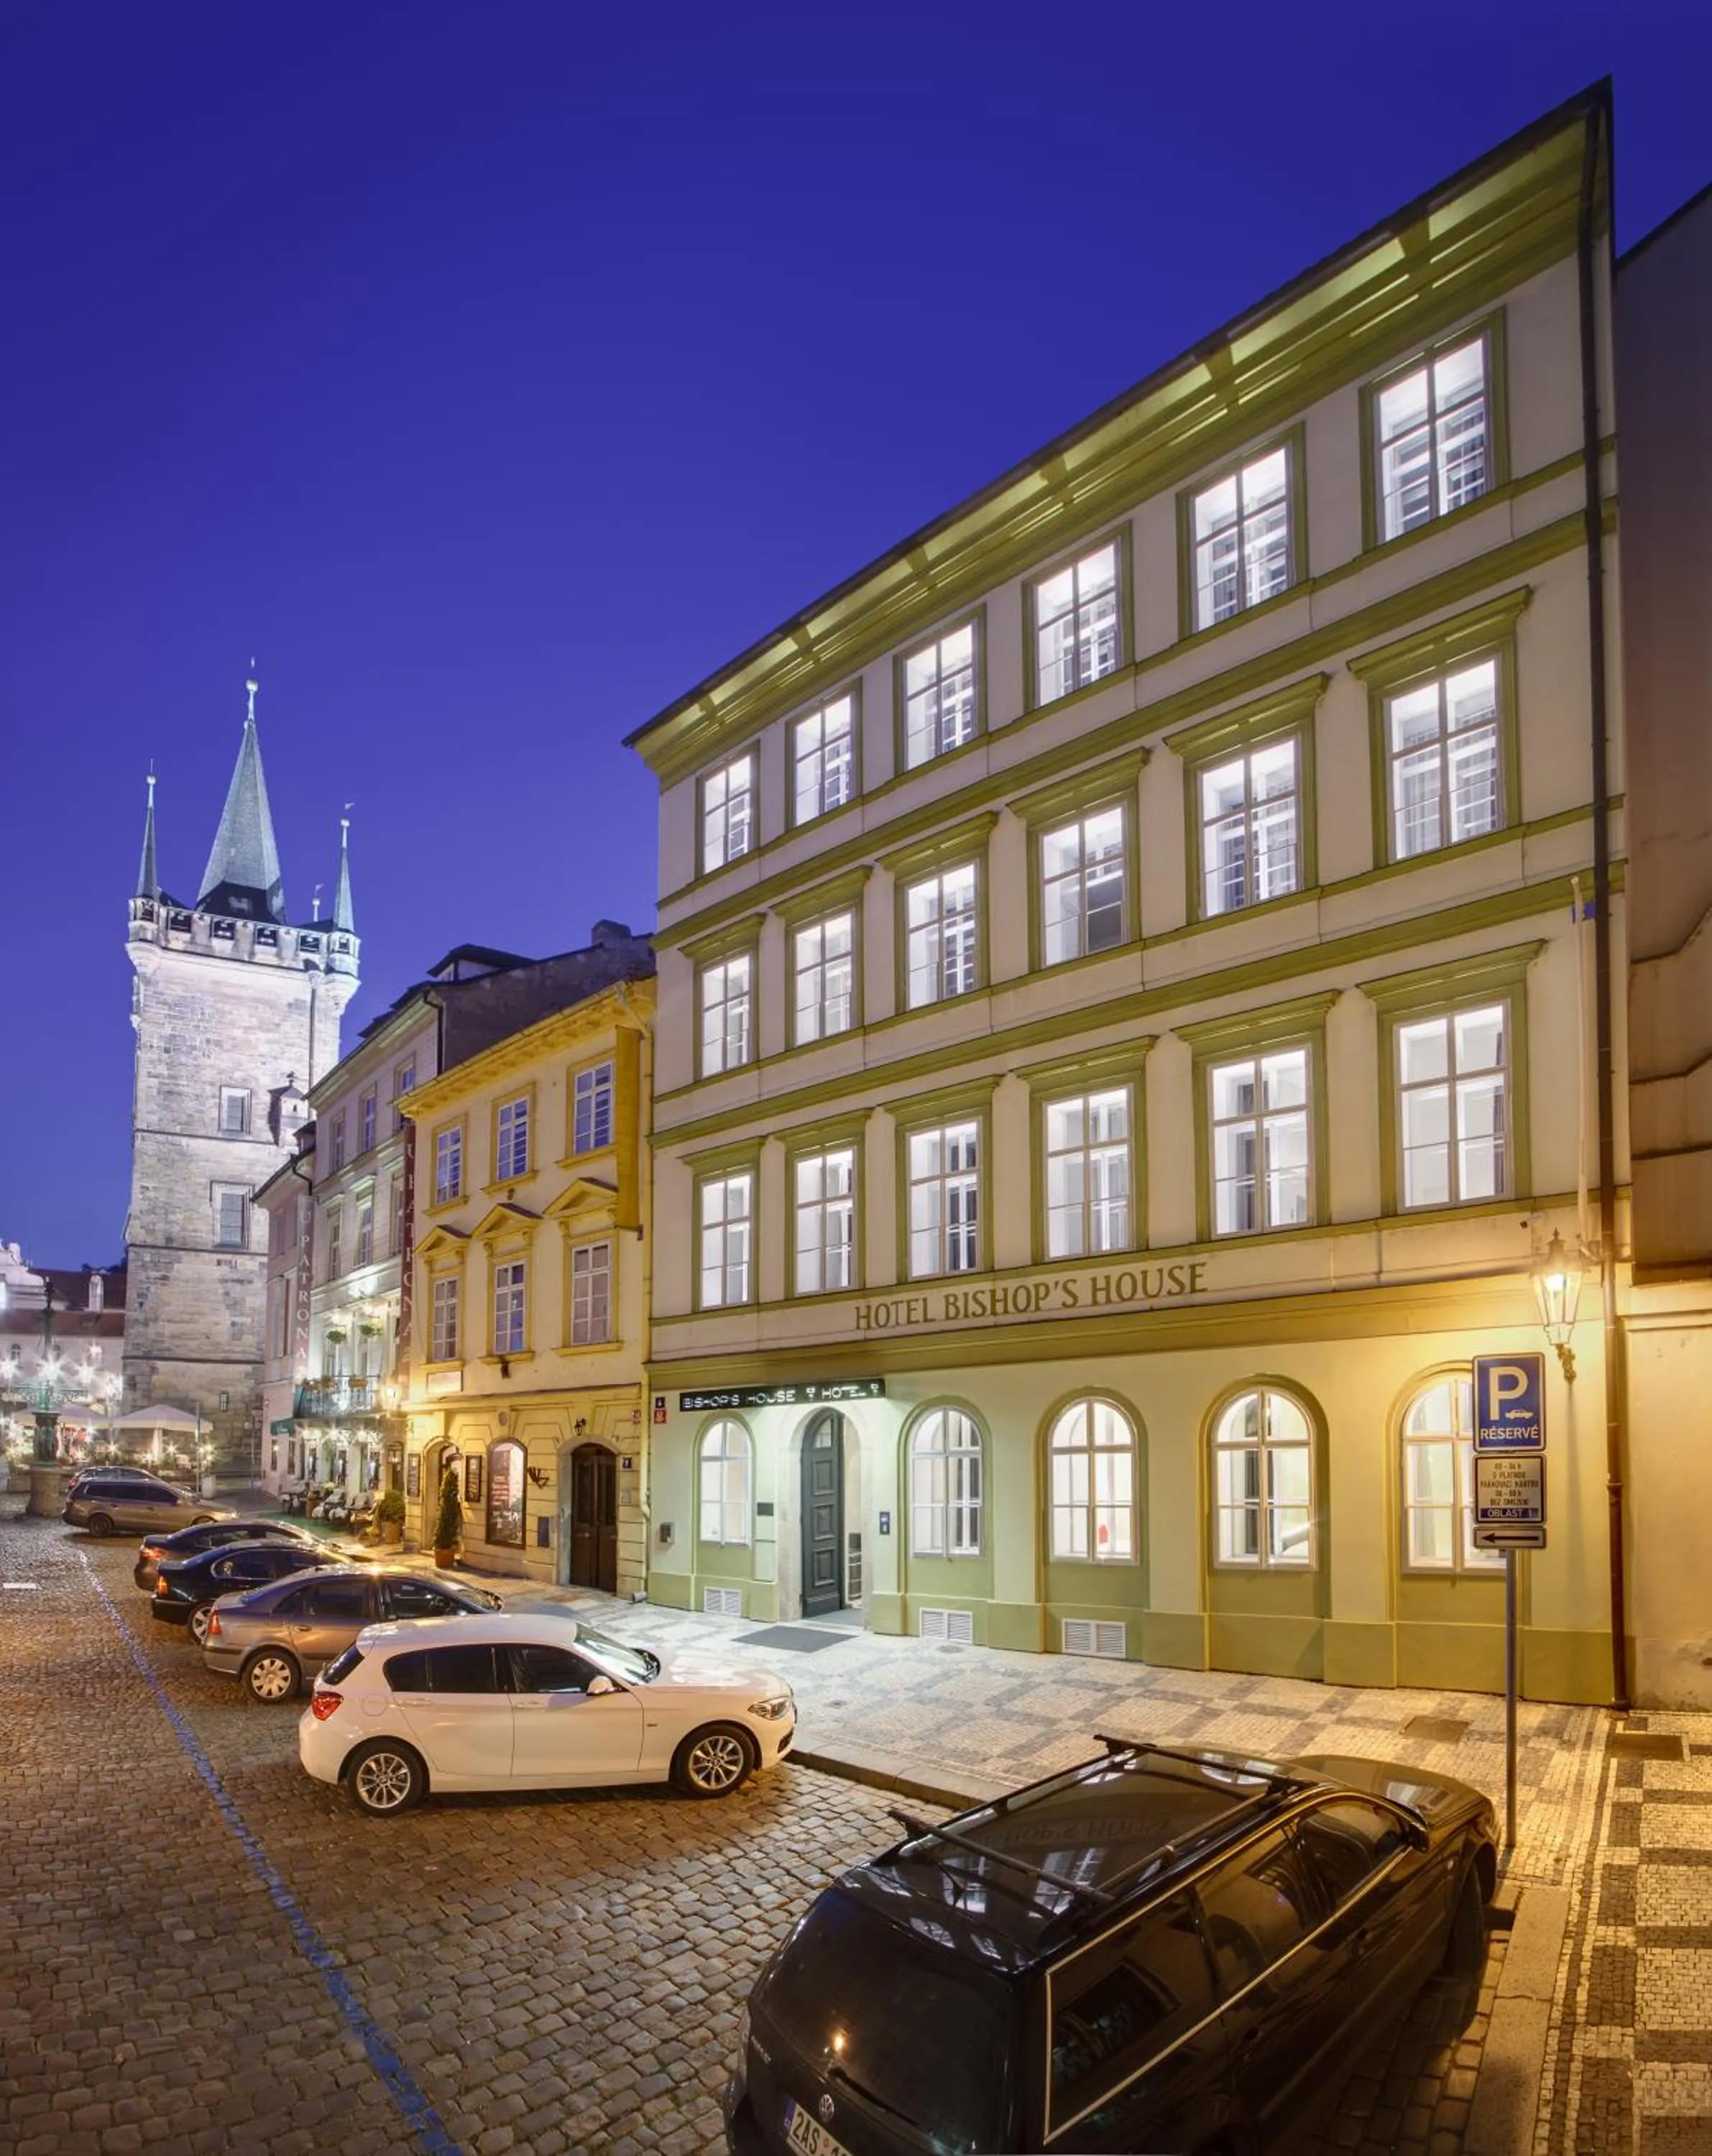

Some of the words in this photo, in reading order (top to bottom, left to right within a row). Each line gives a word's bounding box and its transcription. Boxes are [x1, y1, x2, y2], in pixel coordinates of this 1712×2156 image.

[296, 1235, 310, 1358] PATRONA
[855, 1298, 935, 1330] HOTEL
[944, 1279, 1079, 1321] BISHOP'S
[1090, 1262, 1208, 1307] HOUSE
[1488, 1366, 1528, 1421] P
[1480, 1425, 1539, 1440] RÉSERVÉ
[1487, 1508, 1523, 1518] OBLAST
[792, 2112, 820, 2154] 2AS
